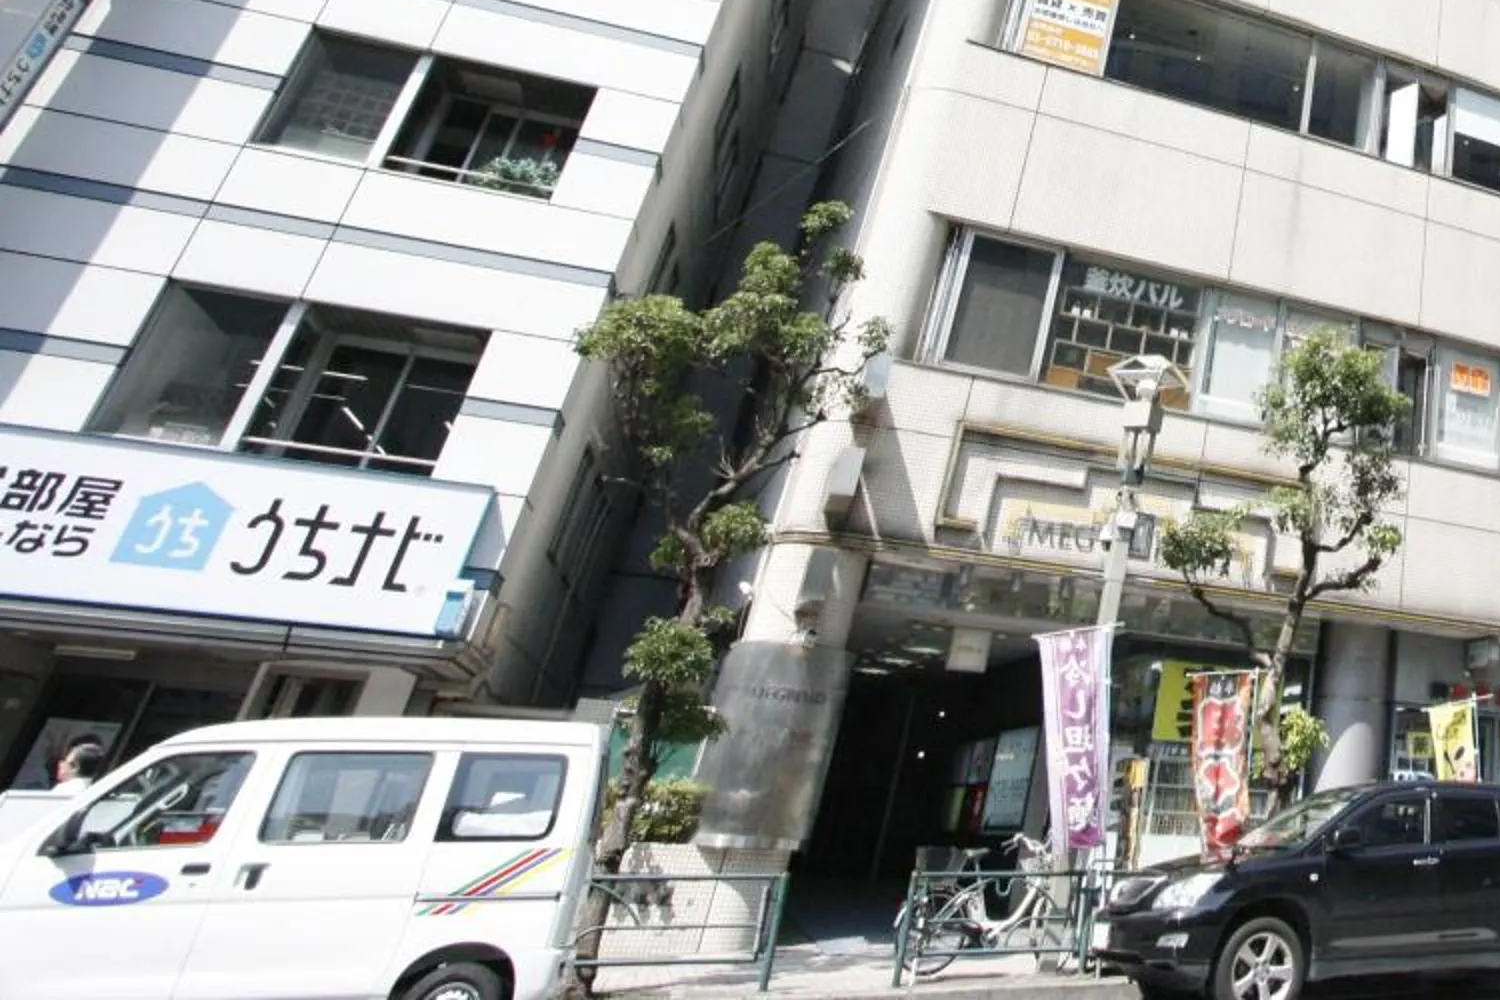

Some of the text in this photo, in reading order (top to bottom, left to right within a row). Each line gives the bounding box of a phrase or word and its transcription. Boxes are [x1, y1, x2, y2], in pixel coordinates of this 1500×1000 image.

[0, 466, 124, 521] 部屋
[0, 520, 96, 558] なら
[135, 503, 209, 558] うち
[229, 498, 444, 593] うちナビ
